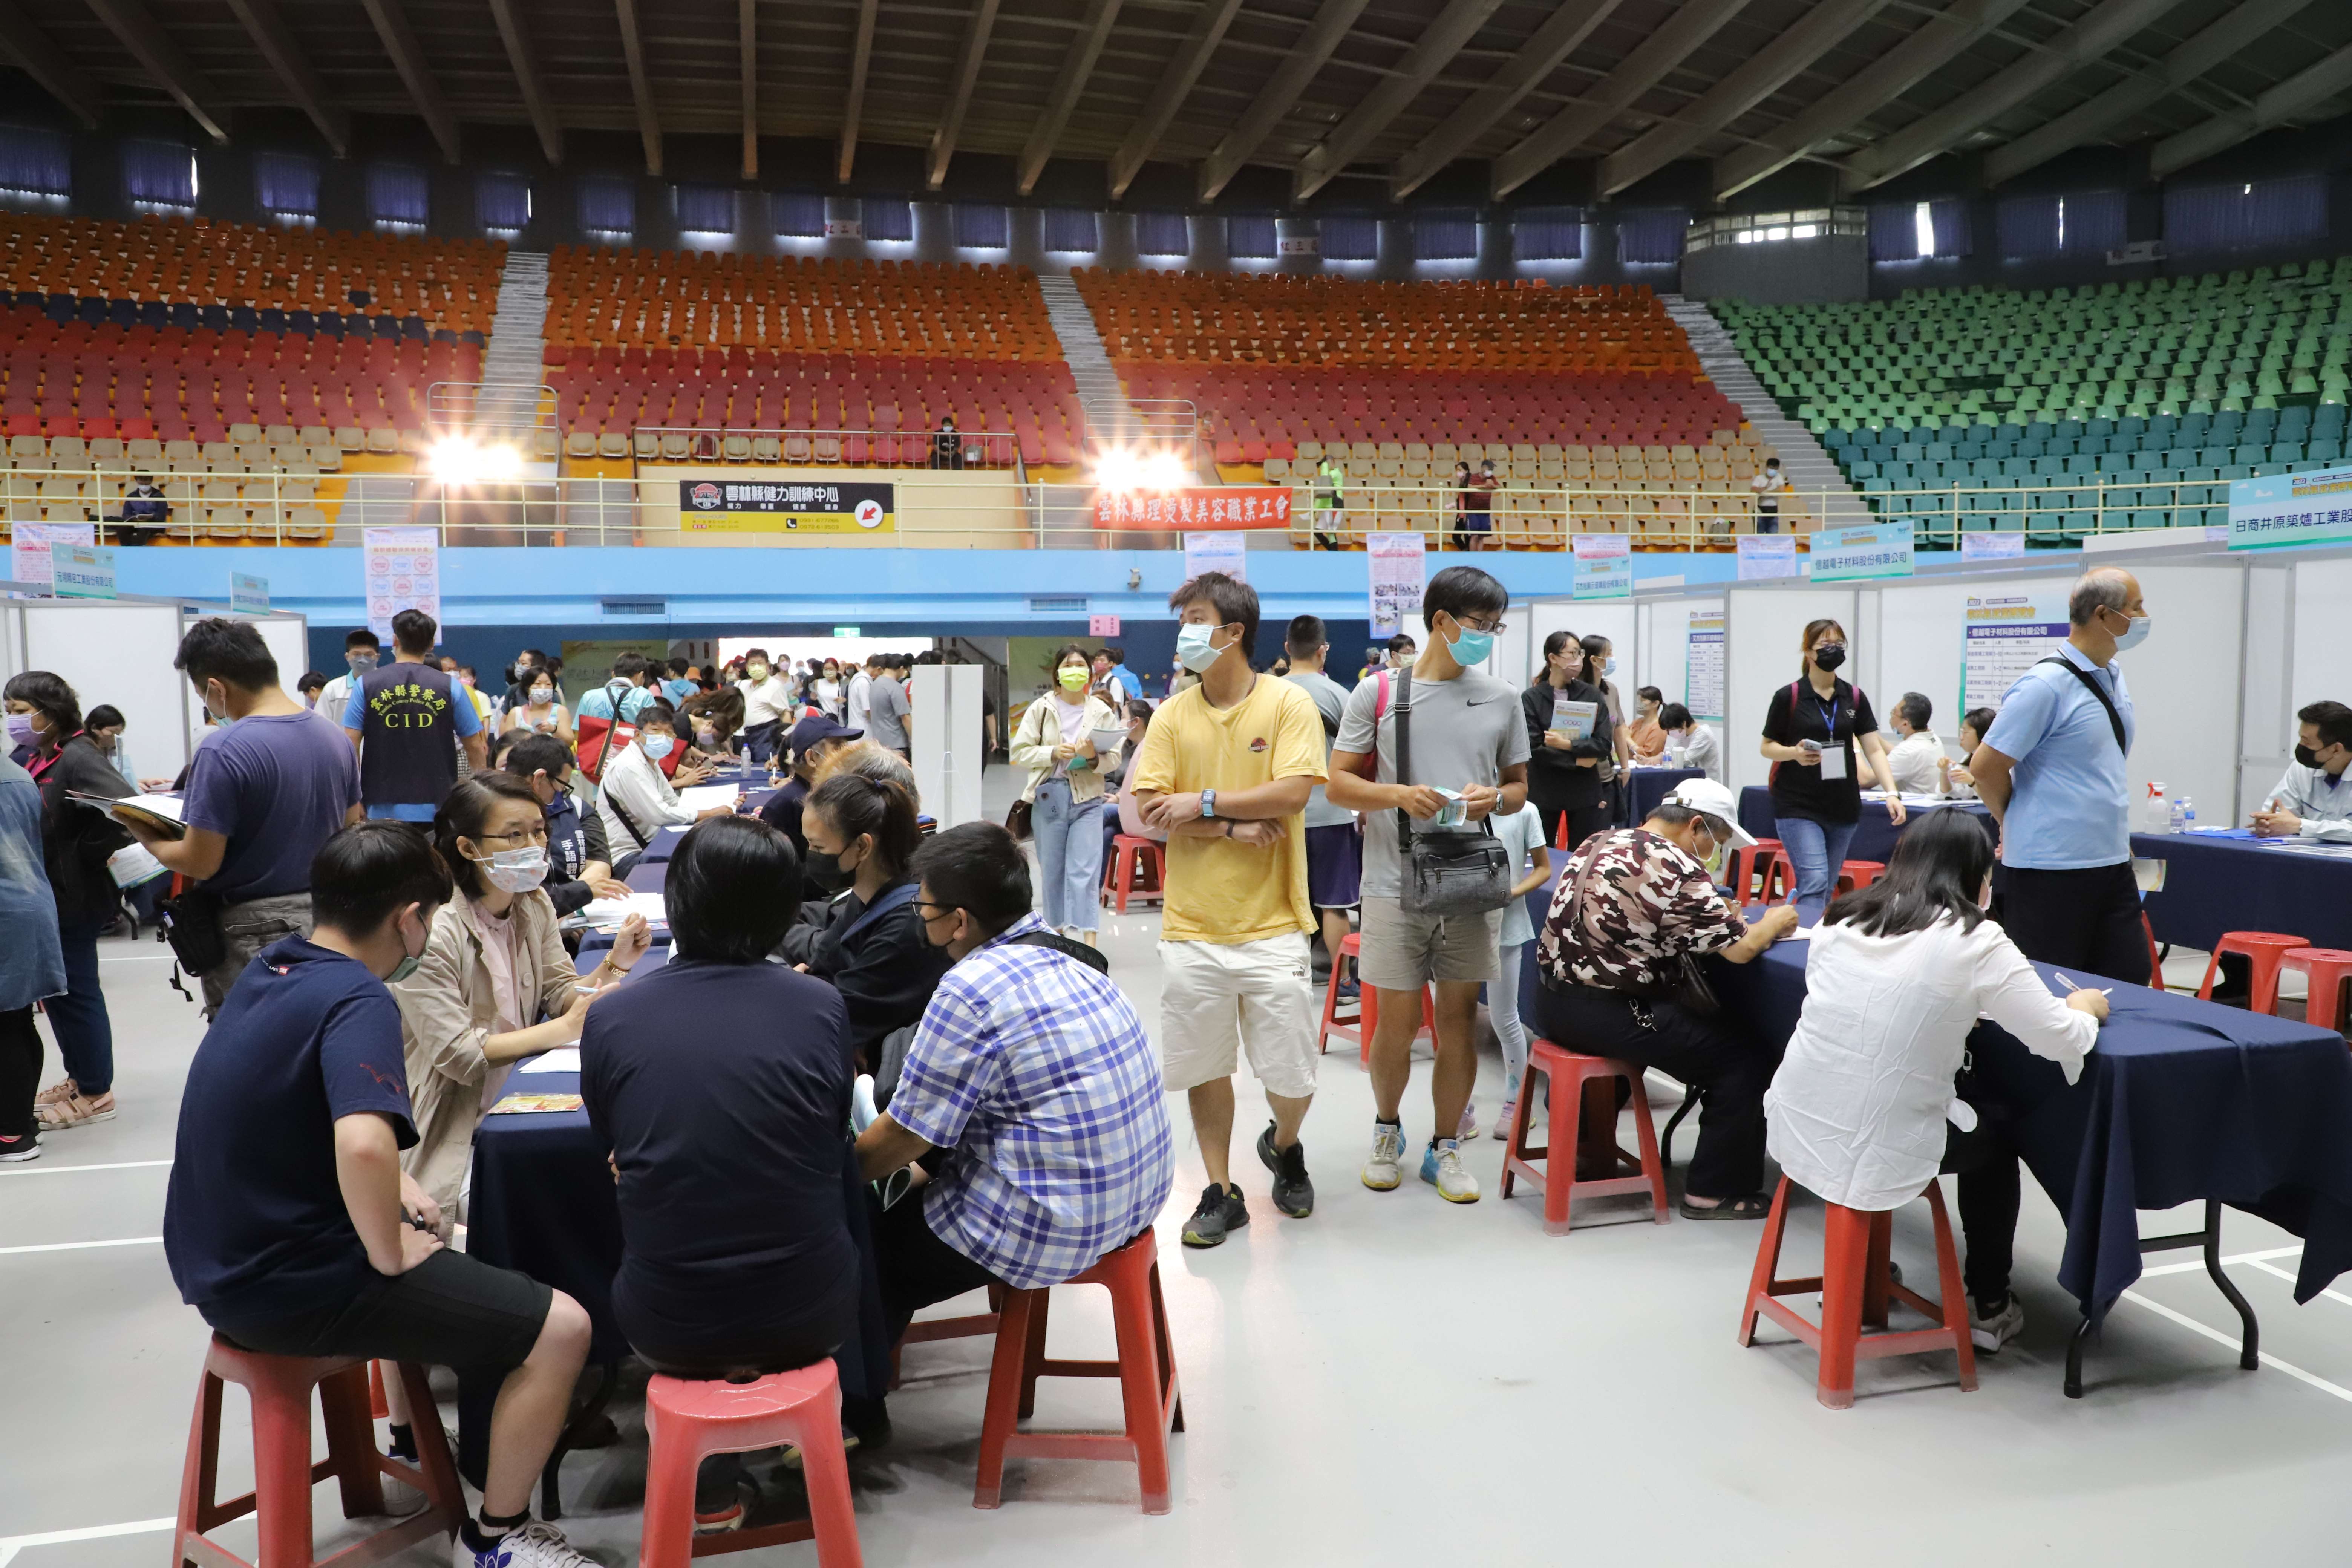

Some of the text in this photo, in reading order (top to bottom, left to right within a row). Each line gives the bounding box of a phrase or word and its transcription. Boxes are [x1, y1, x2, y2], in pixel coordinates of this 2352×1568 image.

[726, 485, 839, 502] 雲林縣健力訓練中心
[1099, 495, 1289, 523] 雲林縣理燙髮美容職業工會
[2236, 508, 2352, 533] 日商井原築爐工業股
[1815, 552, 1907, 570] 信越電子材料股份有限公司
[1972, 626, 2047, 636] 信越電子材料股份有限公司
[371, 684, 446, 711] 雲林縣警察局
